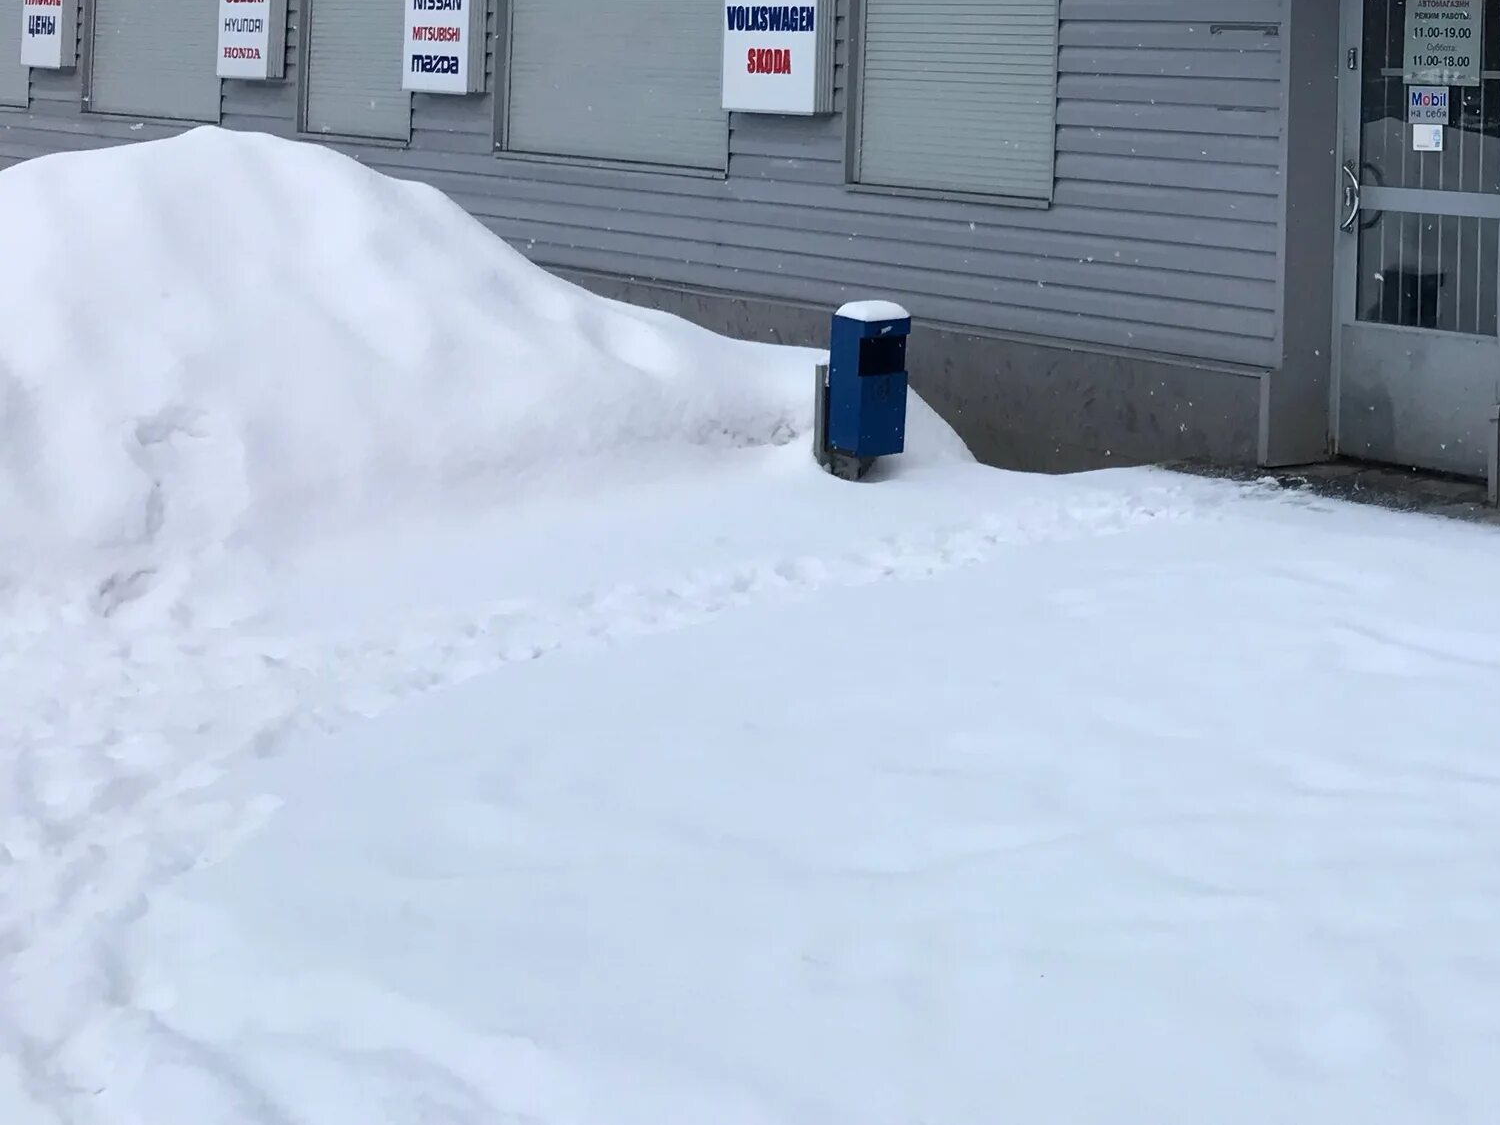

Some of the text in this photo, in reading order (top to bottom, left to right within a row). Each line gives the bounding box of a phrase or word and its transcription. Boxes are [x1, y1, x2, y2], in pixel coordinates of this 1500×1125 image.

[28, 15, 56, 37] ЦЕНЫ
[224, 18, 263, 33] HYUNDAI
[727, 6, 814, 32] VOLKSWAGEN
[412, 26, 460, 42] MITSUBISHI
[1413, 27, 1472, 39] 11.00-19.00
[223, 47, 261, 59] HONDA
[746, 48, 791, 74] SKODA
[1412, 55, 1470, 67] 11.00-18.00
[1411, 92, 1446, 106] Mobil
[1425, 108, 1446, 118] себя
